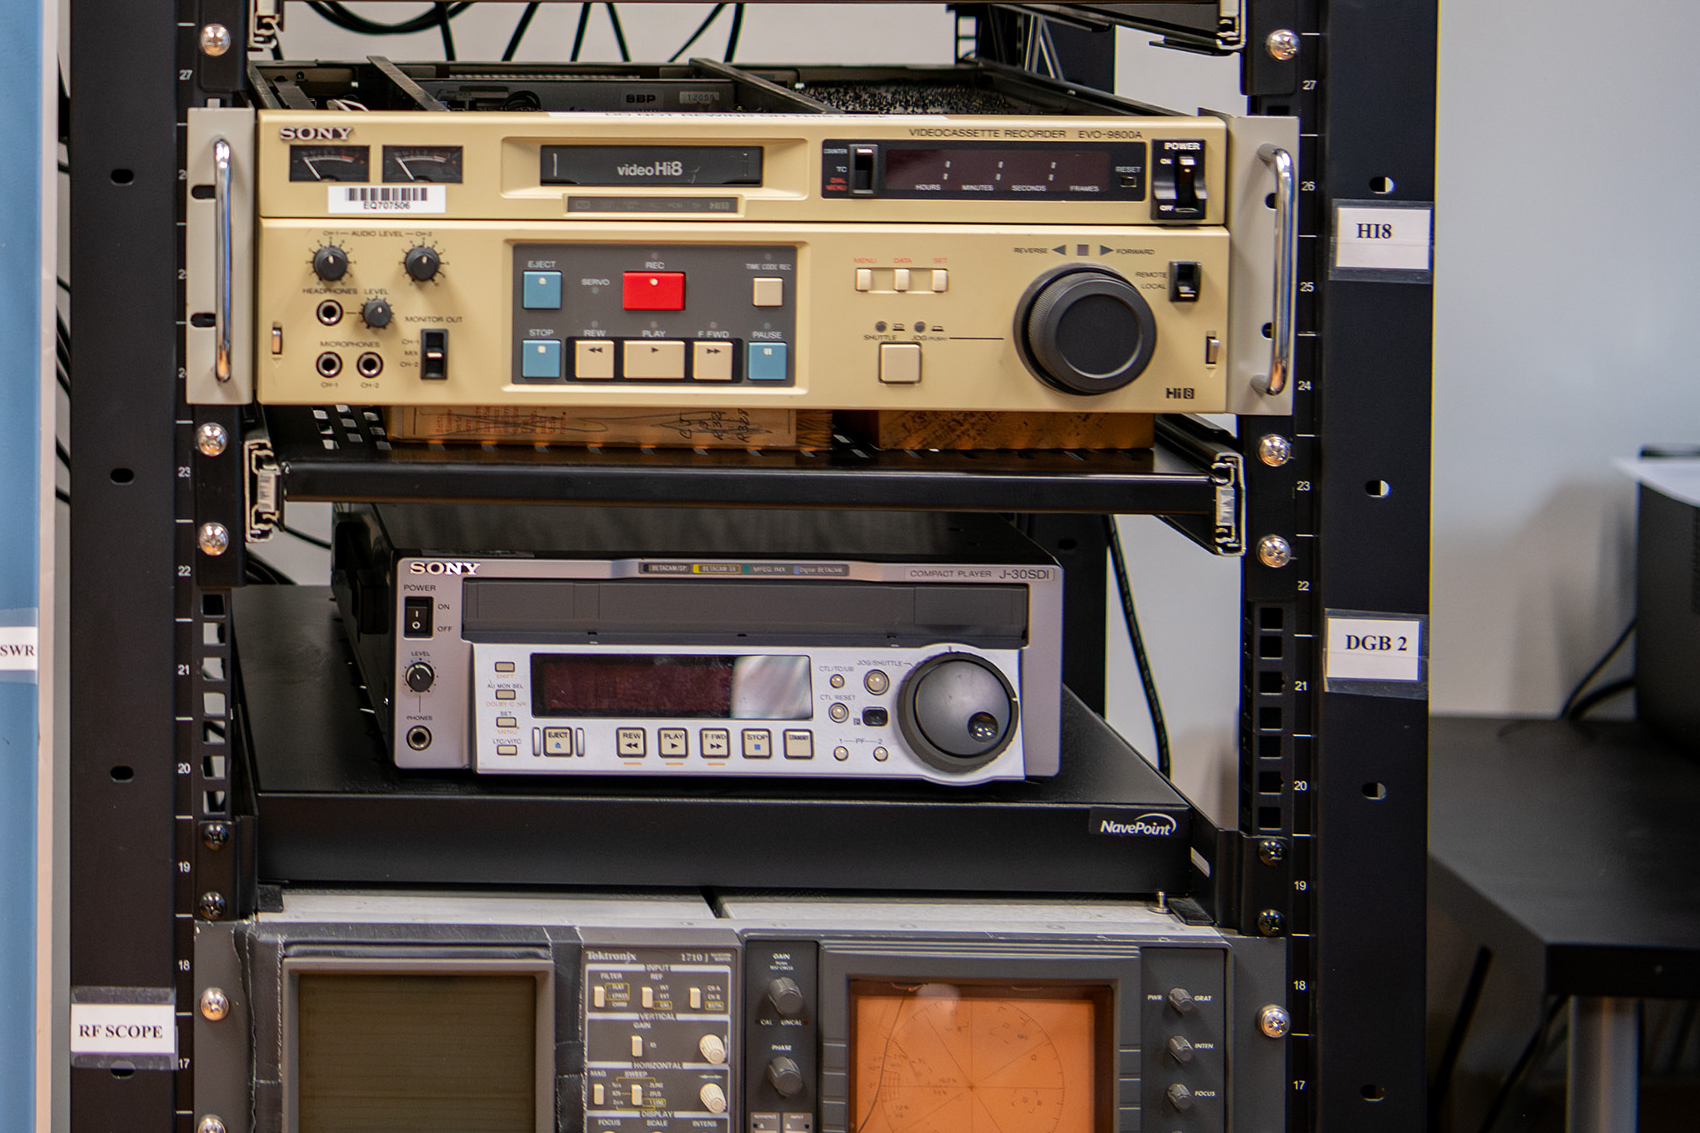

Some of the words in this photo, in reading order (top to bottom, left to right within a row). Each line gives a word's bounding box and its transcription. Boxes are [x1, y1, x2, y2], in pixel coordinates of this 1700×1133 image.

[280, 127, 353, 140] SONY
[909, 129, 1000, 137] VIDEOCASSETTE
[1004, 130, 1066, 138] RECORDER
[618, 164, 653, 175] video
[656, 162, 682, 175] Hi8
[363, 202, 410, 210] EQ707506
[1357, 223, 1392, 240] HI8
[1301, 282, 1314, 292] 25
[410, 562, 481, 575] SONY
[999, 568, 1049, 580] J-30SDI
[1346, 634, 1392, 651] DGB
[1398, 637, 1408, 652] 2
[1101, 820, 1172, 836] NavePoint
[586, 952, 636, 961] Tektronix
[79, 1025, 102, 1038] RF
[106, 1025, 163, 1039] SCOPE
[1293, 1081, 1305, 1090] 17
